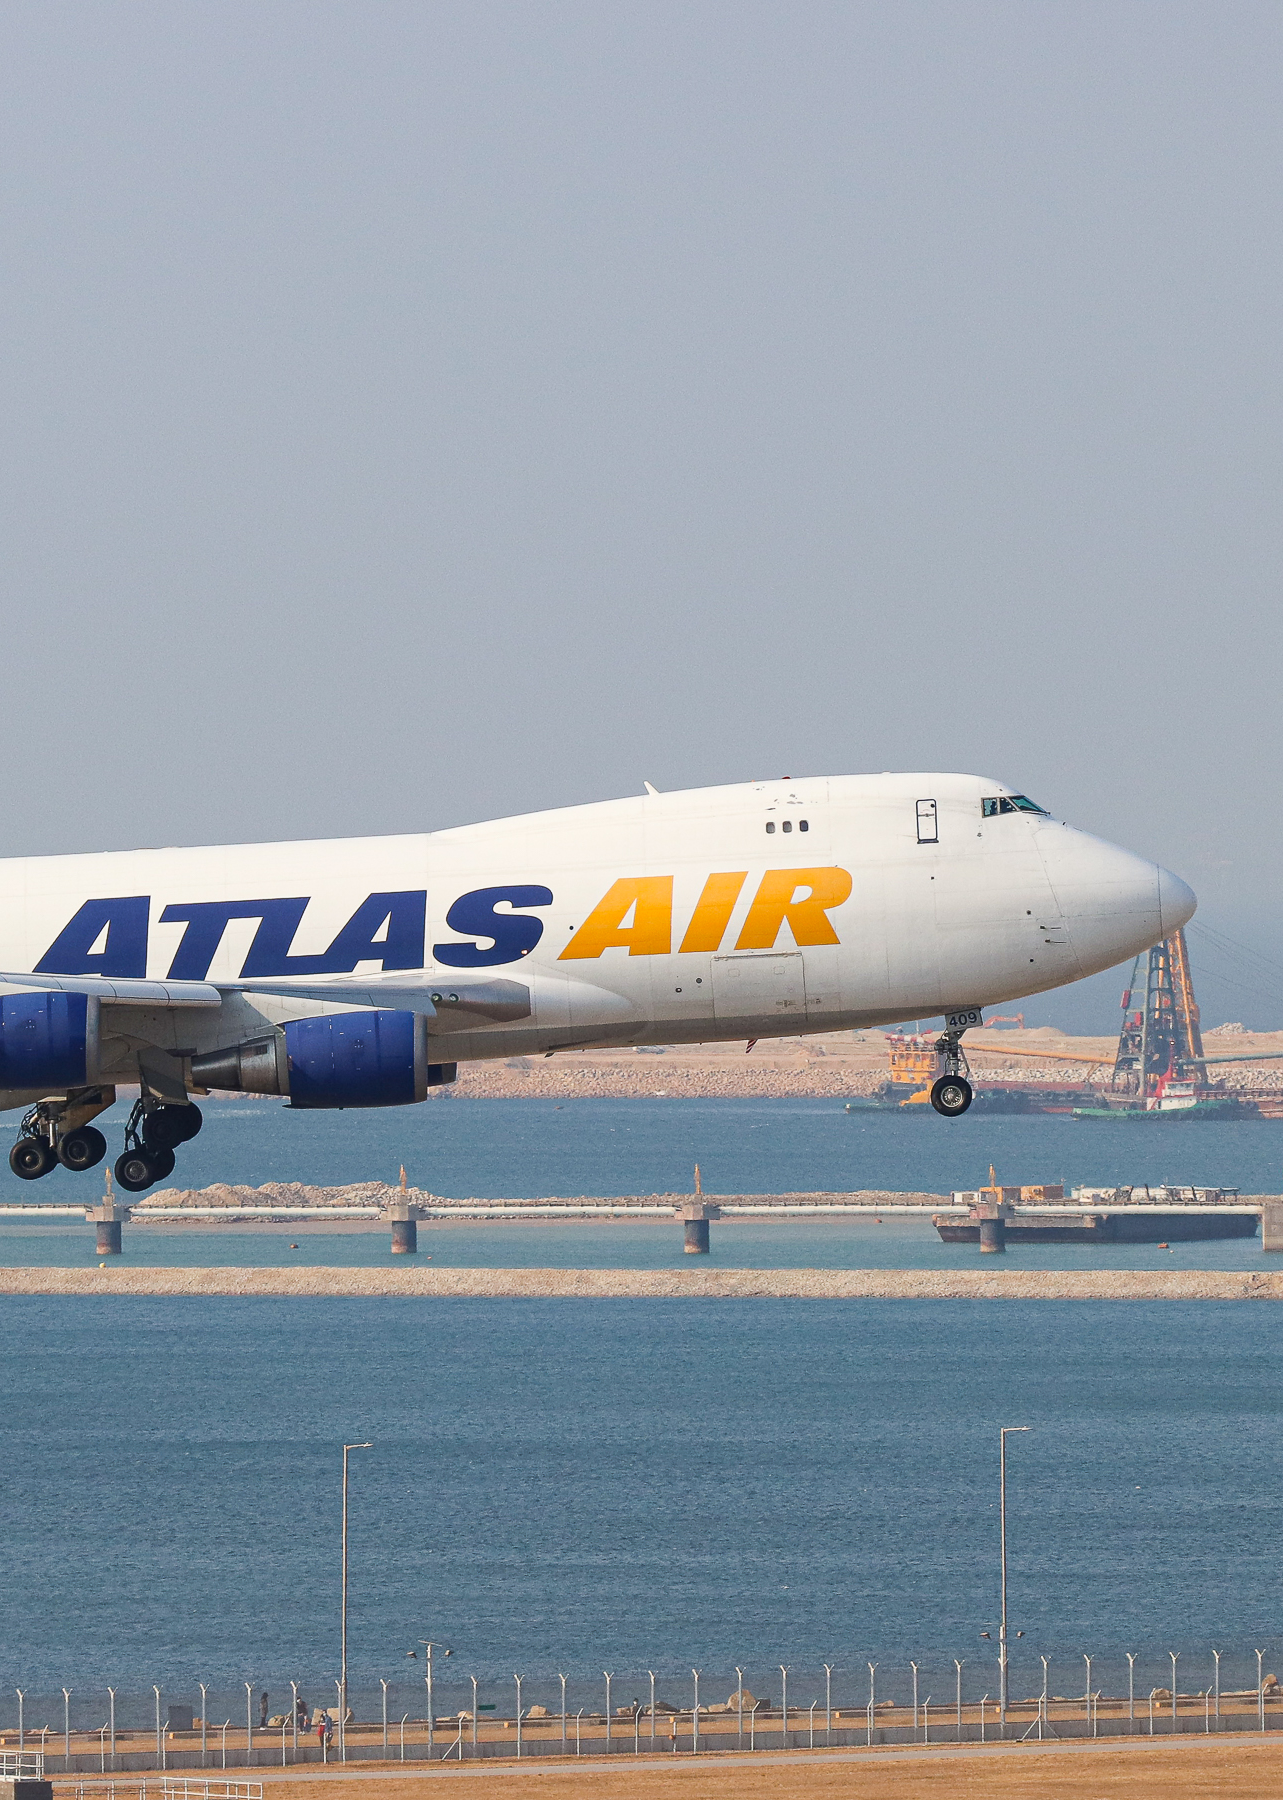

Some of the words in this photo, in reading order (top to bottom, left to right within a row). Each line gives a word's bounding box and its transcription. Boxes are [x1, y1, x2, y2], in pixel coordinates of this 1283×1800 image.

[32, 884, 554, 981] ATLAS
[557, 866, 853, 960] AIR
[949, 1011, 978, 1027] 409
